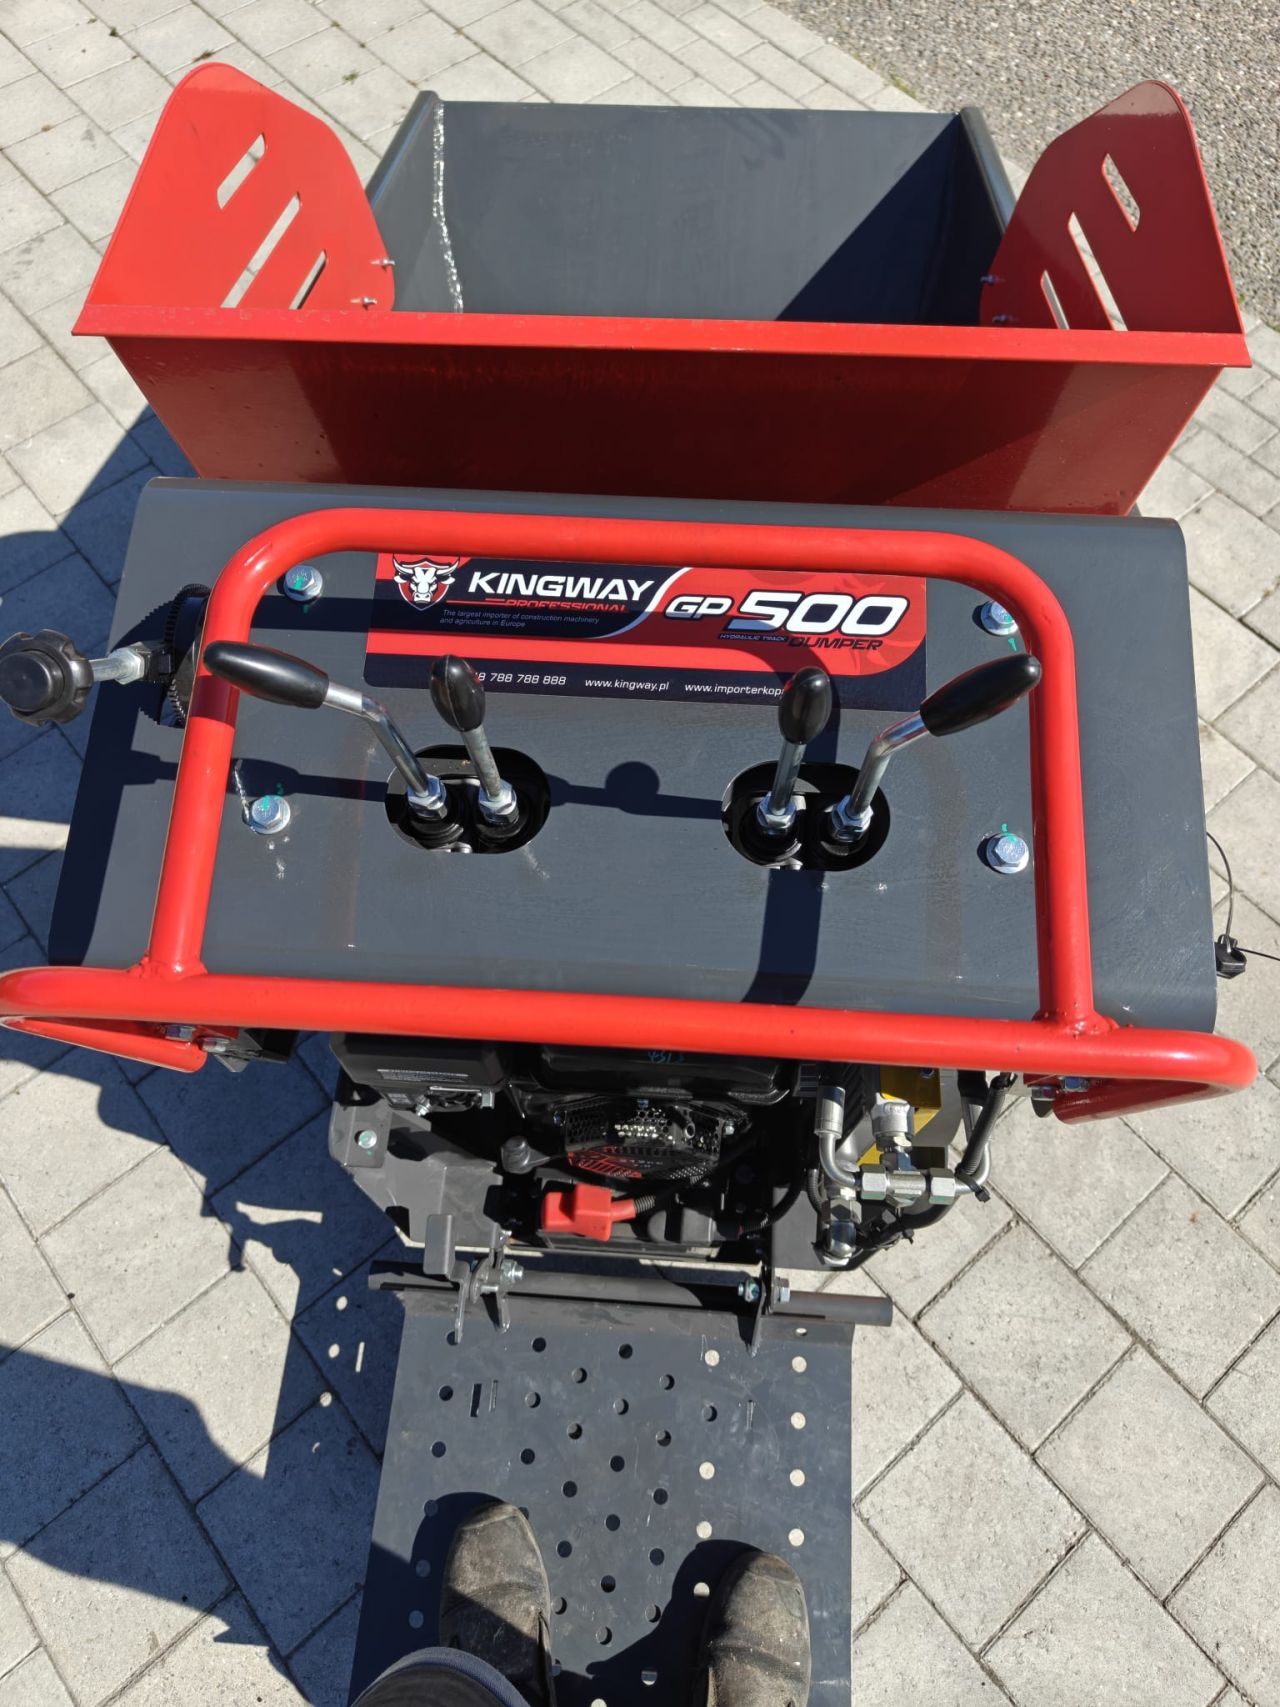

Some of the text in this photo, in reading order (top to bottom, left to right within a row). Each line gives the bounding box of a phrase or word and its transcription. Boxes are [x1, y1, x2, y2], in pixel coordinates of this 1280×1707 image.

[468, 571, 655, 601] KINGWAY
[443, 609, 457, 617] The
[457, 610, 481, 619] largest
[483, 611, 511, 620] importer
[520, 613, 562, 622] construction
[564, 615, 599, 625] machinery
[664, 590, 910, 636] GP 500
[455, 617, 491, 626] agriculture
[500, 620, 525, 628] Europe
[788, 636, 883, 650] DUMPER
[490, 672, 512, 683] 788
[517, 674, 540, 684] 788
[542, 675, 566, 685] 888
[585, 678, 669, 692] www.kingway.pl
